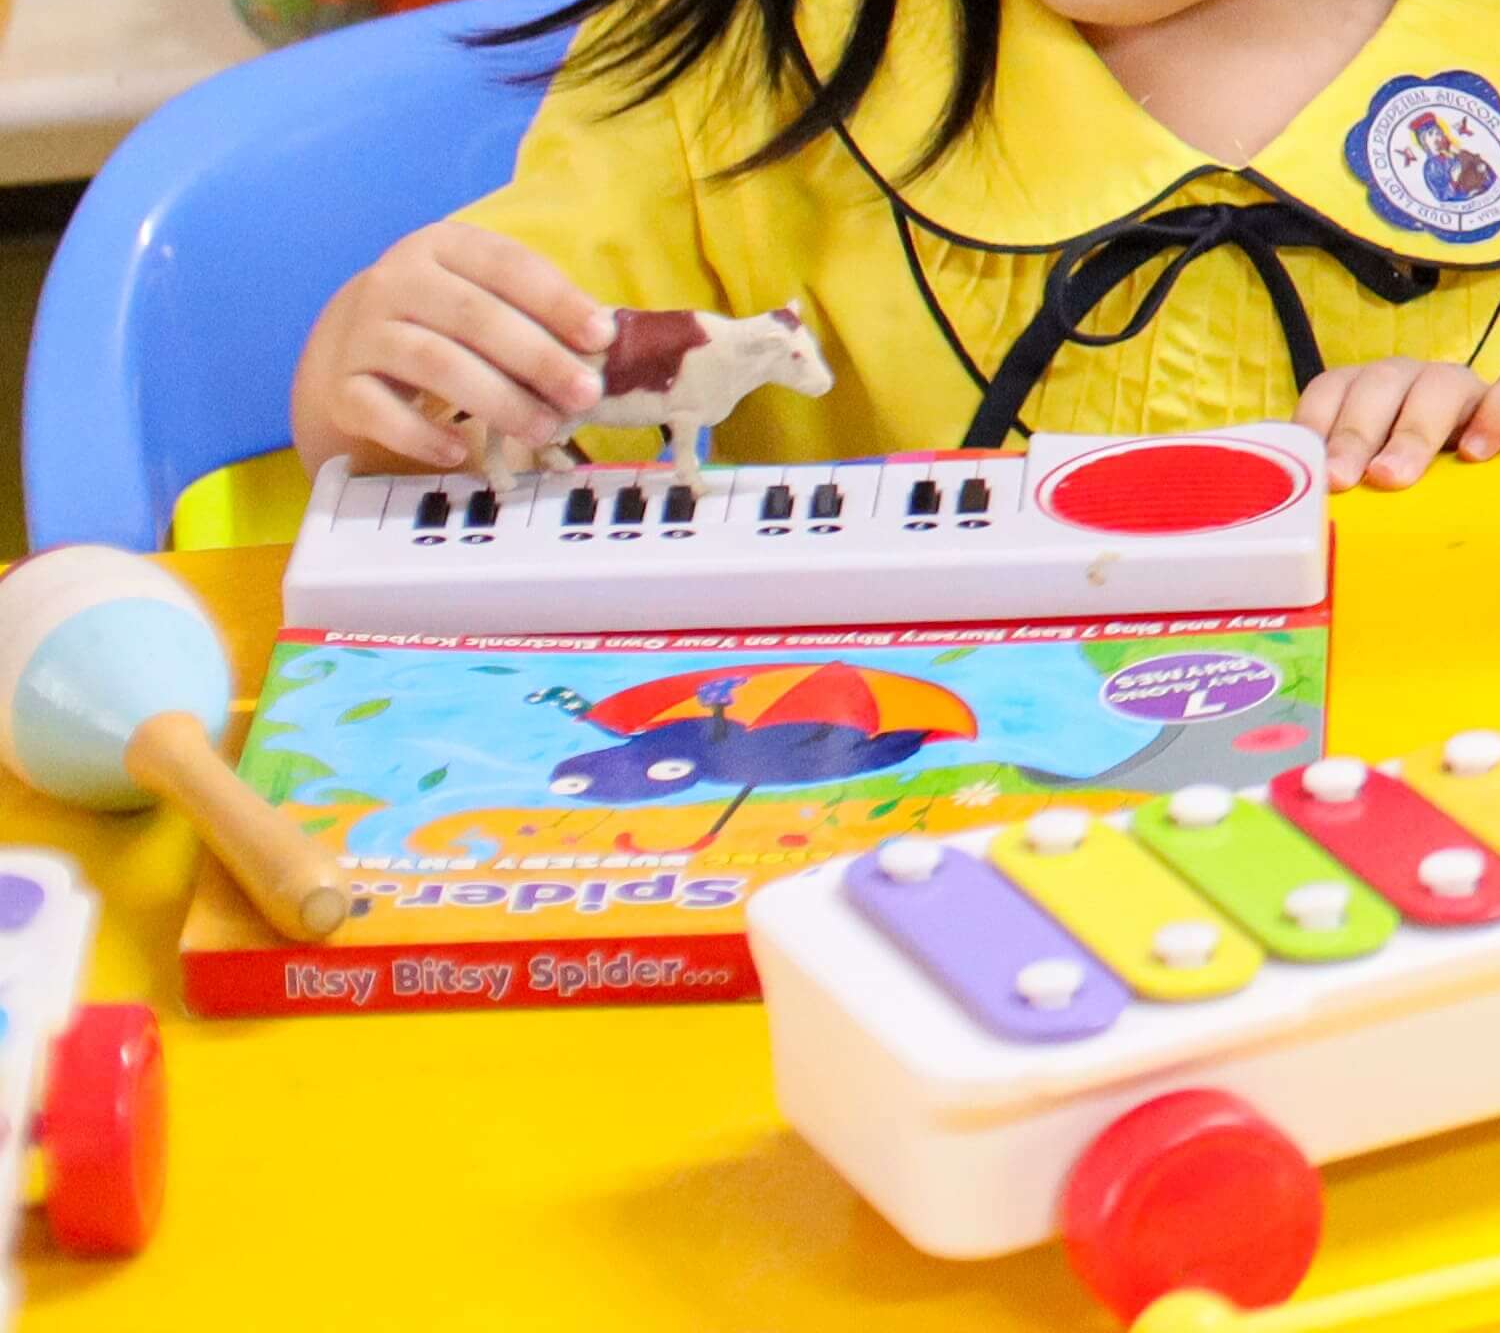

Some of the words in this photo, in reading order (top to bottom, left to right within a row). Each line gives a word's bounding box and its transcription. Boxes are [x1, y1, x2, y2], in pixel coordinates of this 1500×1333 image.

[1435, 89, 1500, 130] SUCCOR
[1103, 621, 1167, 637] Sing
[1168, 618, 1225, 633] and
[1227, 615, 1288, 631] Play
[324, 631, 456, 651] Keyboard
[459, 634, 596, 651] Electronic
[784, 630, 892, 648] Rhymes
[899, 628, 1010, 646] Nursery
[1013, 625, 1079, 642] Easy
[603, 636, 668, 651] Own
[671, 636, 738, 650] Your
[1114, 657, 1251, 689] RHYMES
[1206, 668, 1272, 690] PLAY
[1108, 679, 1201, 703] ALONG
[1182, 690, 1226, 718] 7
[491, 853, 690, 871] NURSERY
[284, 963, 378, 1006] Itsy
[391, 958, 513, 1001] Bitsy
